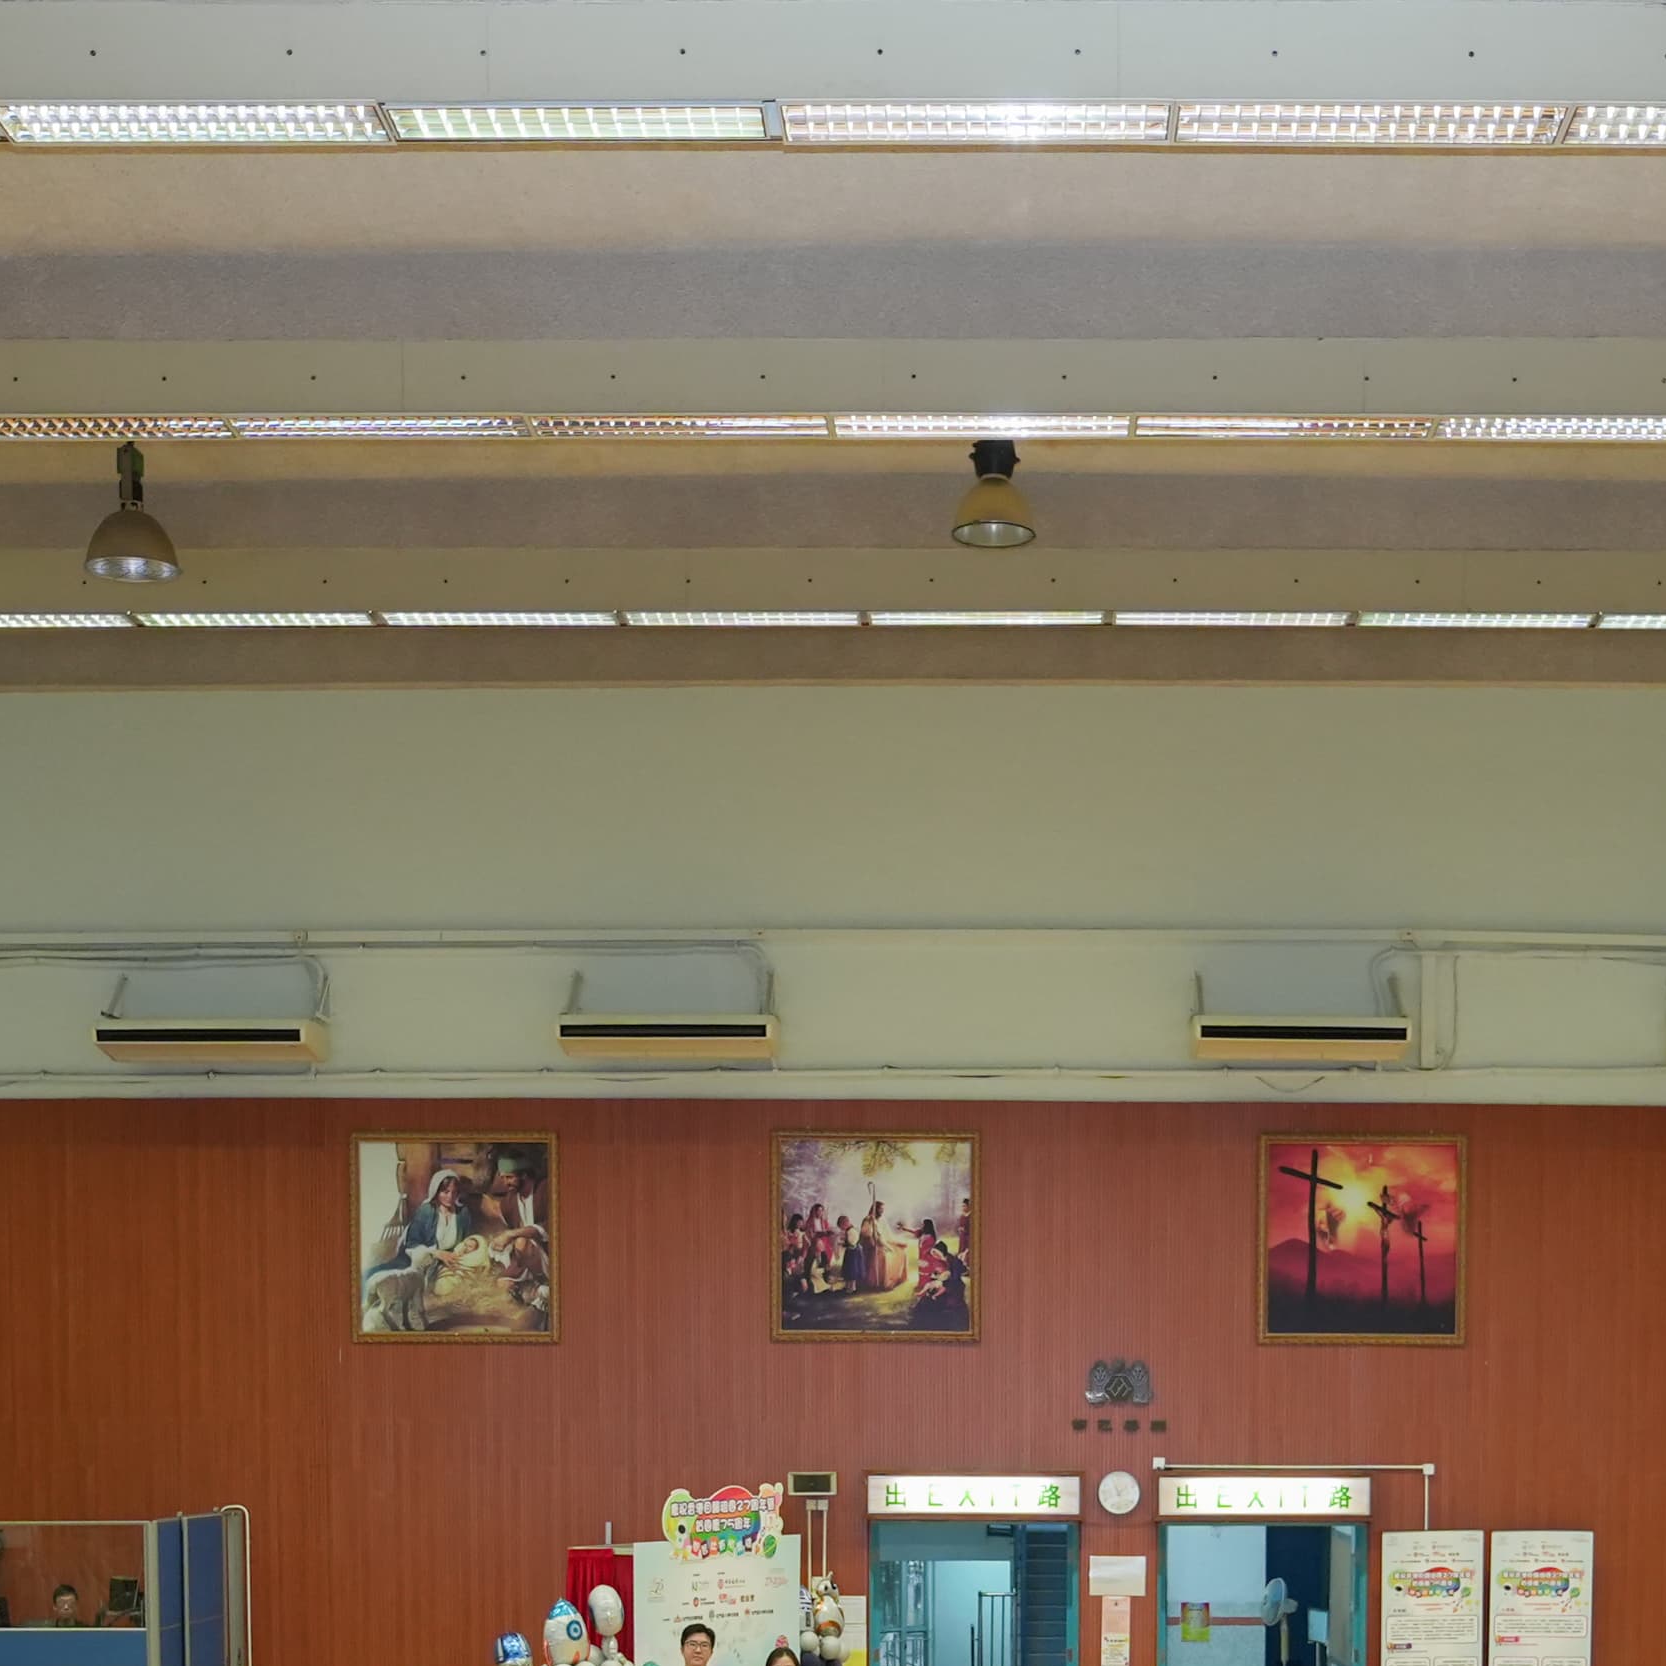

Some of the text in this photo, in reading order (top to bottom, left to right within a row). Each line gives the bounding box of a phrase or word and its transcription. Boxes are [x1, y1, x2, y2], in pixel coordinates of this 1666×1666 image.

[885, 1483, 907, 1506] 出
[1037, 1484, 1061, 1508] 路
[1177, 1484, 1198, 1508] 出
[1329, 1485, 1353, 1509] 路
